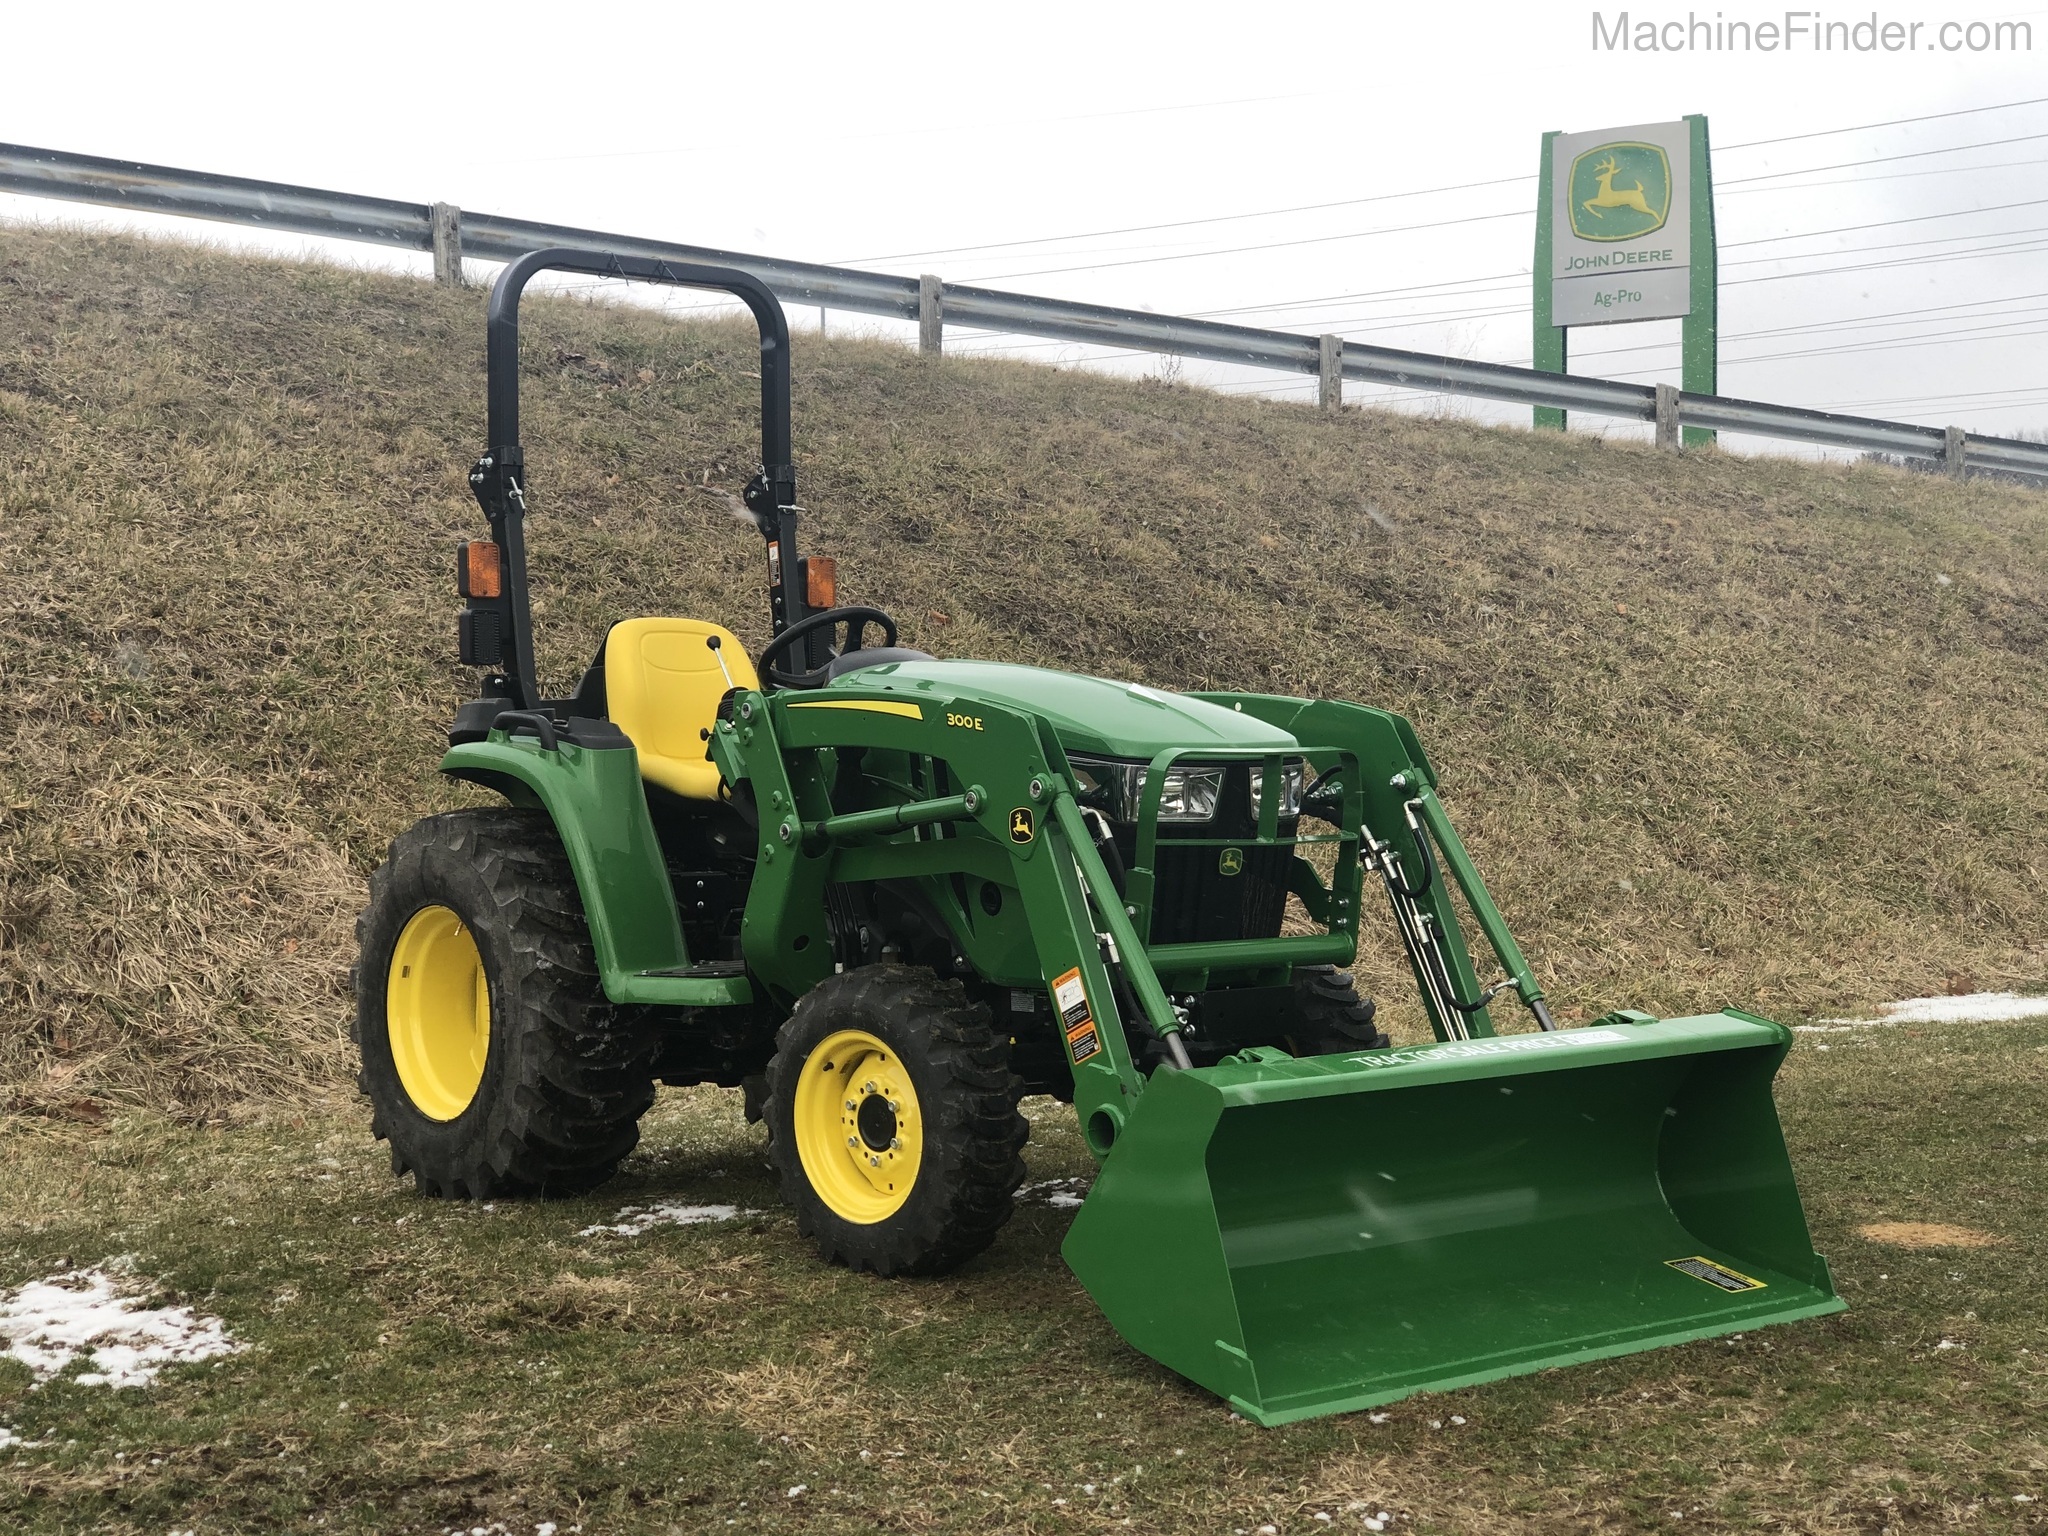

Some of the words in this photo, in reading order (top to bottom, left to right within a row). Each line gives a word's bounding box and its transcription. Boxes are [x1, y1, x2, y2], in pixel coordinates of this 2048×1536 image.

[1564, 254, 1610, 271] JOHN
[1612, 249, 1673, 266] DEERE
[1594, 289, 1642, 308] Ag-Pro
[1346, 1049, 1449, 1067] TRACTOR
[1447, 1043, 1509, 1058] SALE
[1500, 1037, 1567, 1051] PRICE
